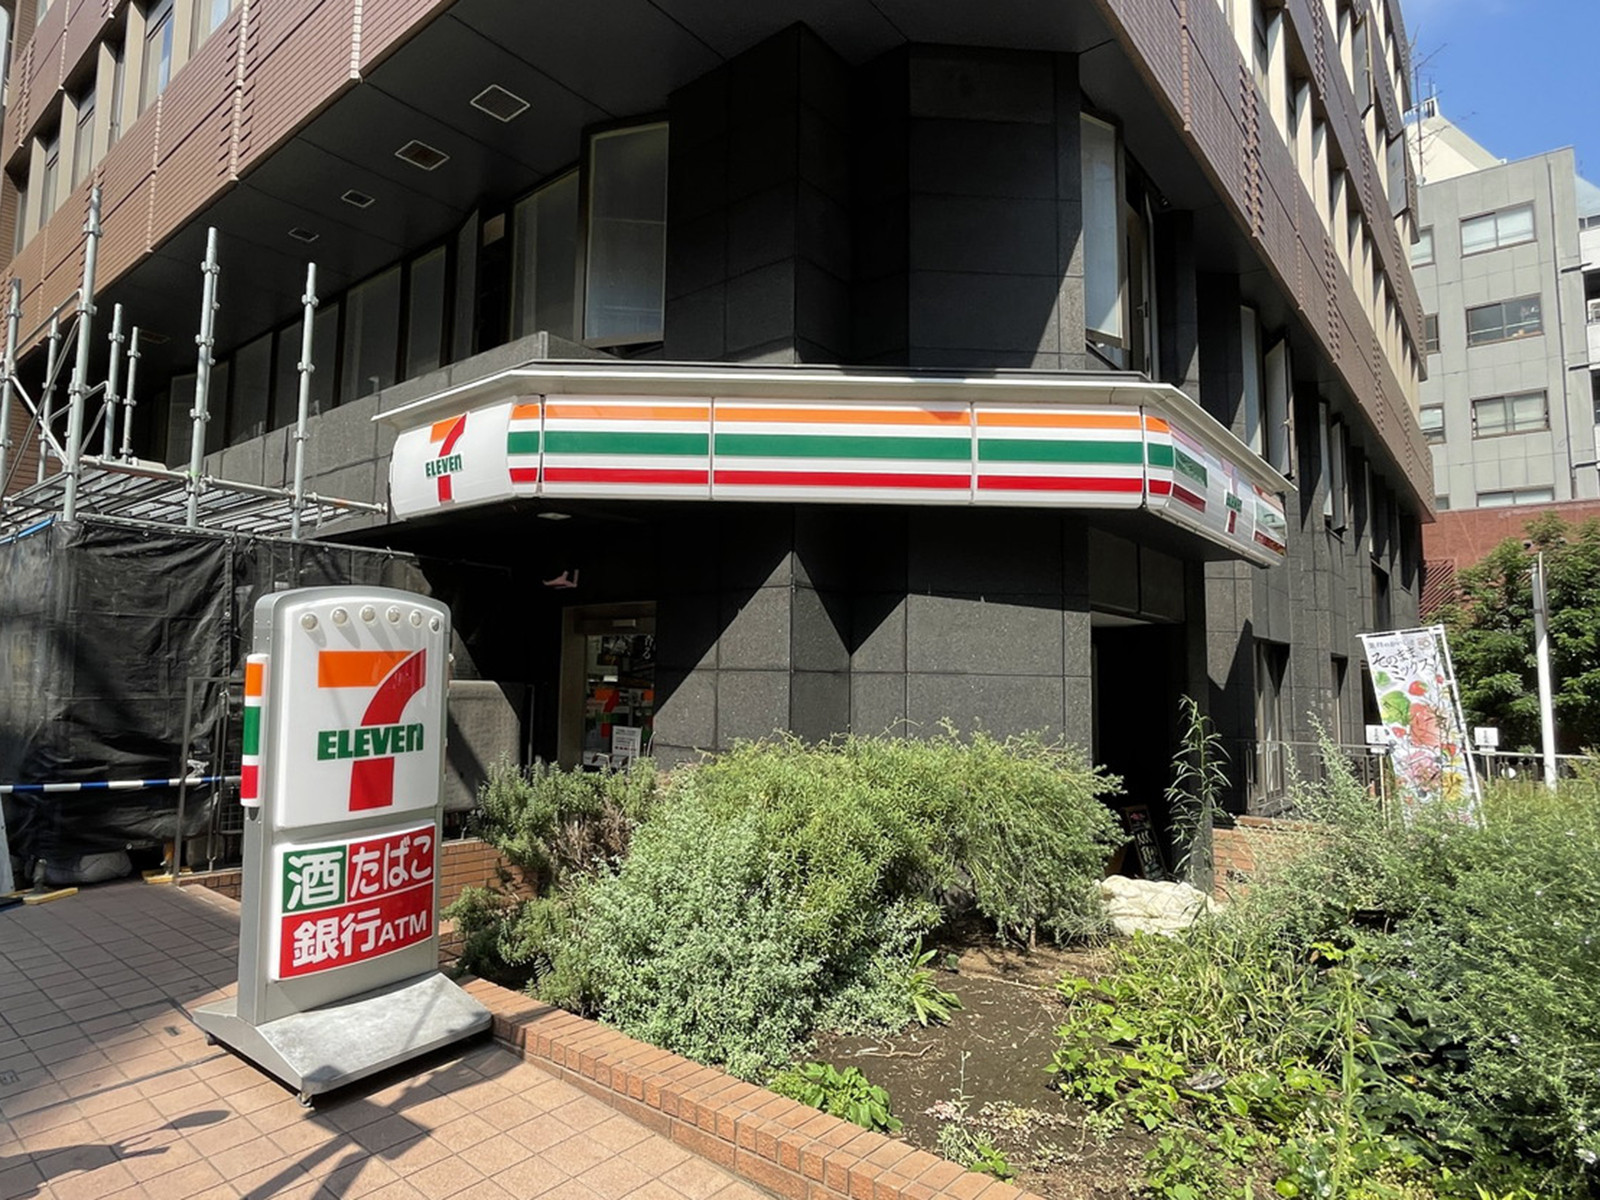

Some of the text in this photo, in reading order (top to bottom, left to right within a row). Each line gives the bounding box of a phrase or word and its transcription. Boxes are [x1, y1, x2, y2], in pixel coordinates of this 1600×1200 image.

[430, 413, 467, 502] 7
[318, 648, 426, 811] 7
[286, 834, 433, 911] 酒 たばこ
